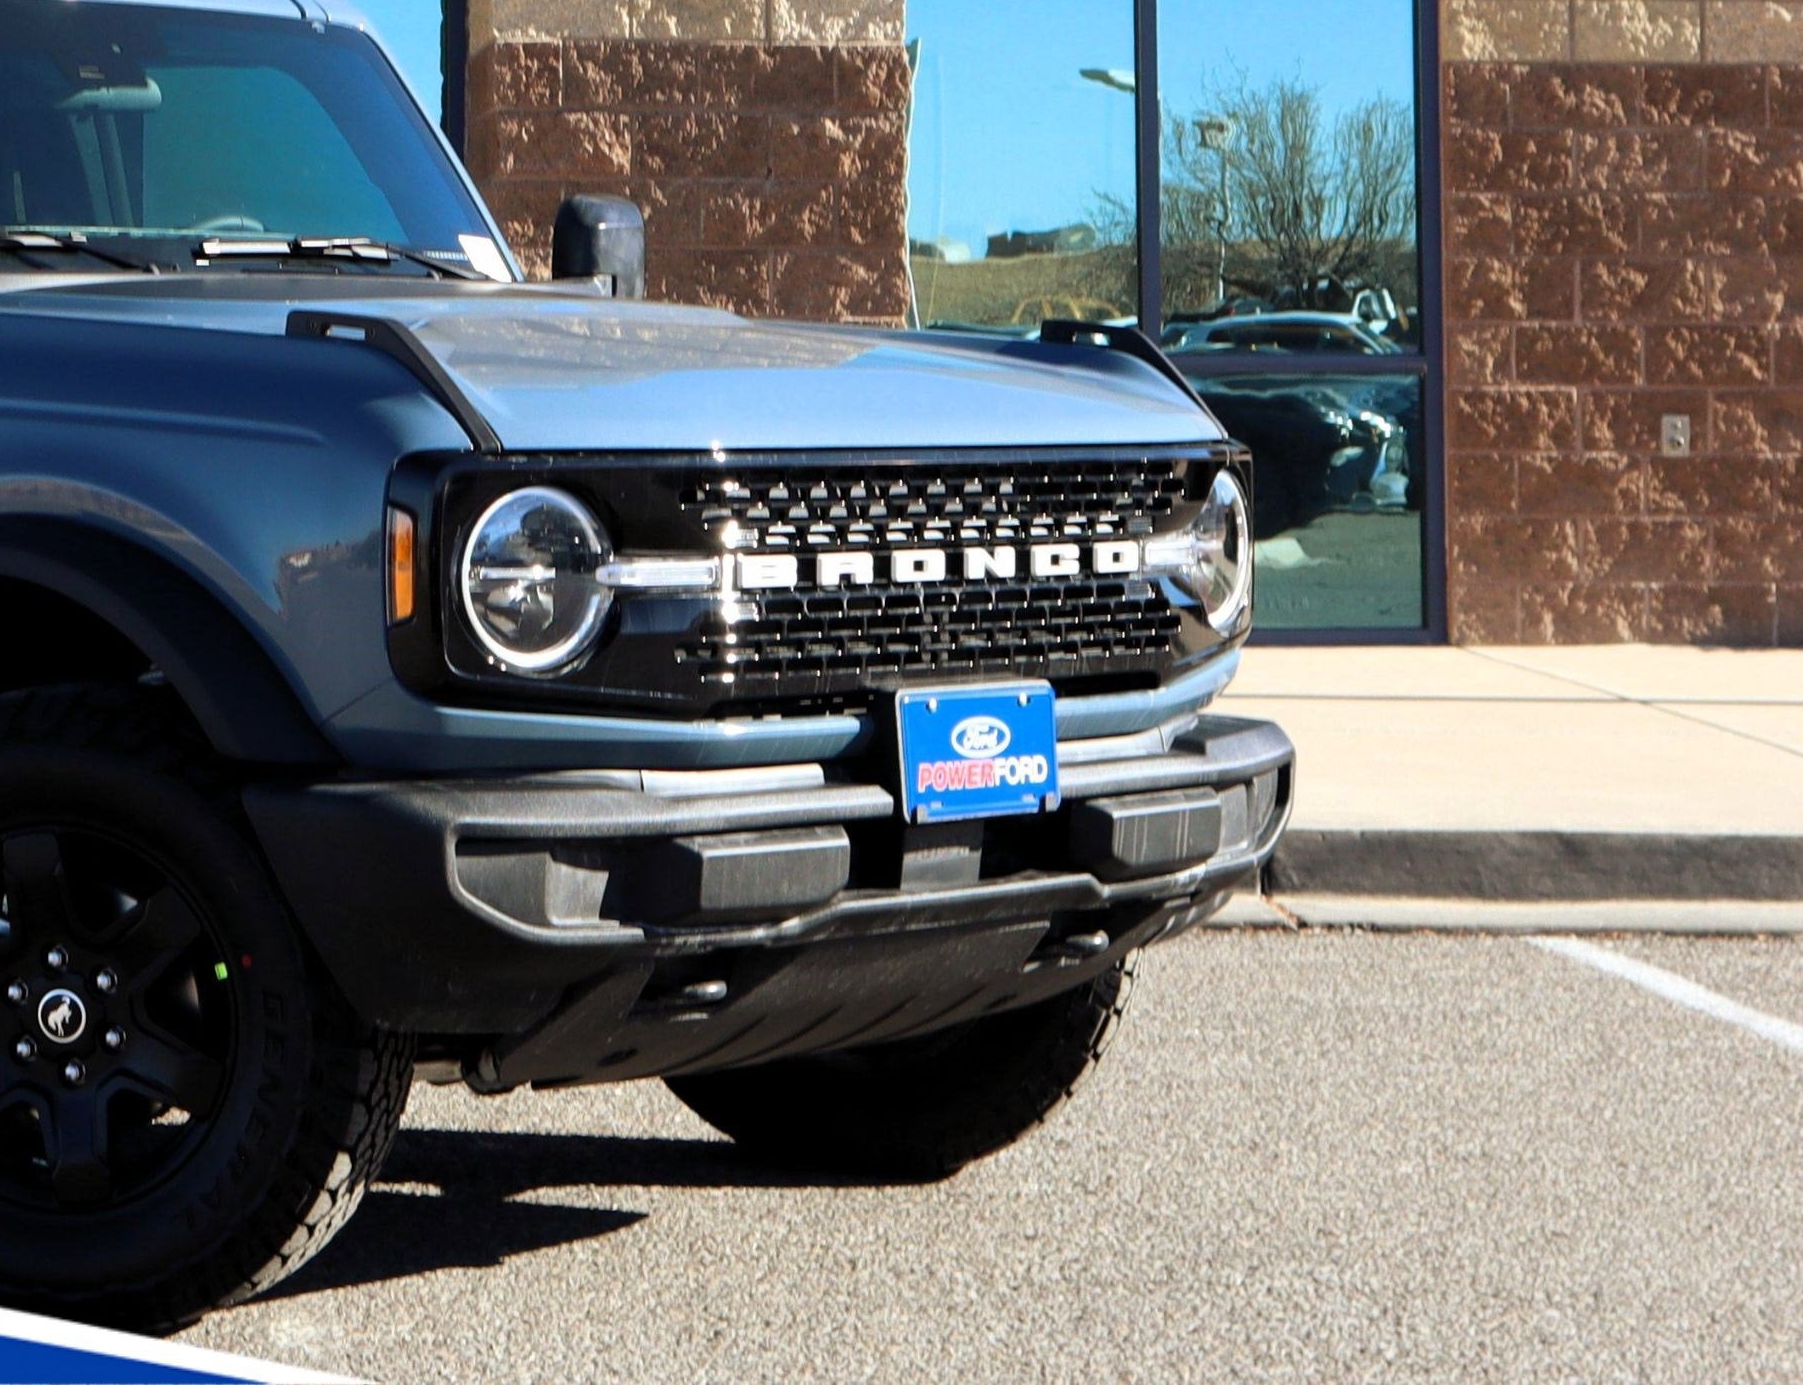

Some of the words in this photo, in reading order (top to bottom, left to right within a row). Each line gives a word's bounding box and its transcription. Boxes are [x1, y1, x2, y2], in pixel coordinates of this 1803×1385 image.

[736, 540, 1141, 589] BRONCO
[963, 724, 998, 750] Ford
[918, 754, 1048, 793] POWERFORD
